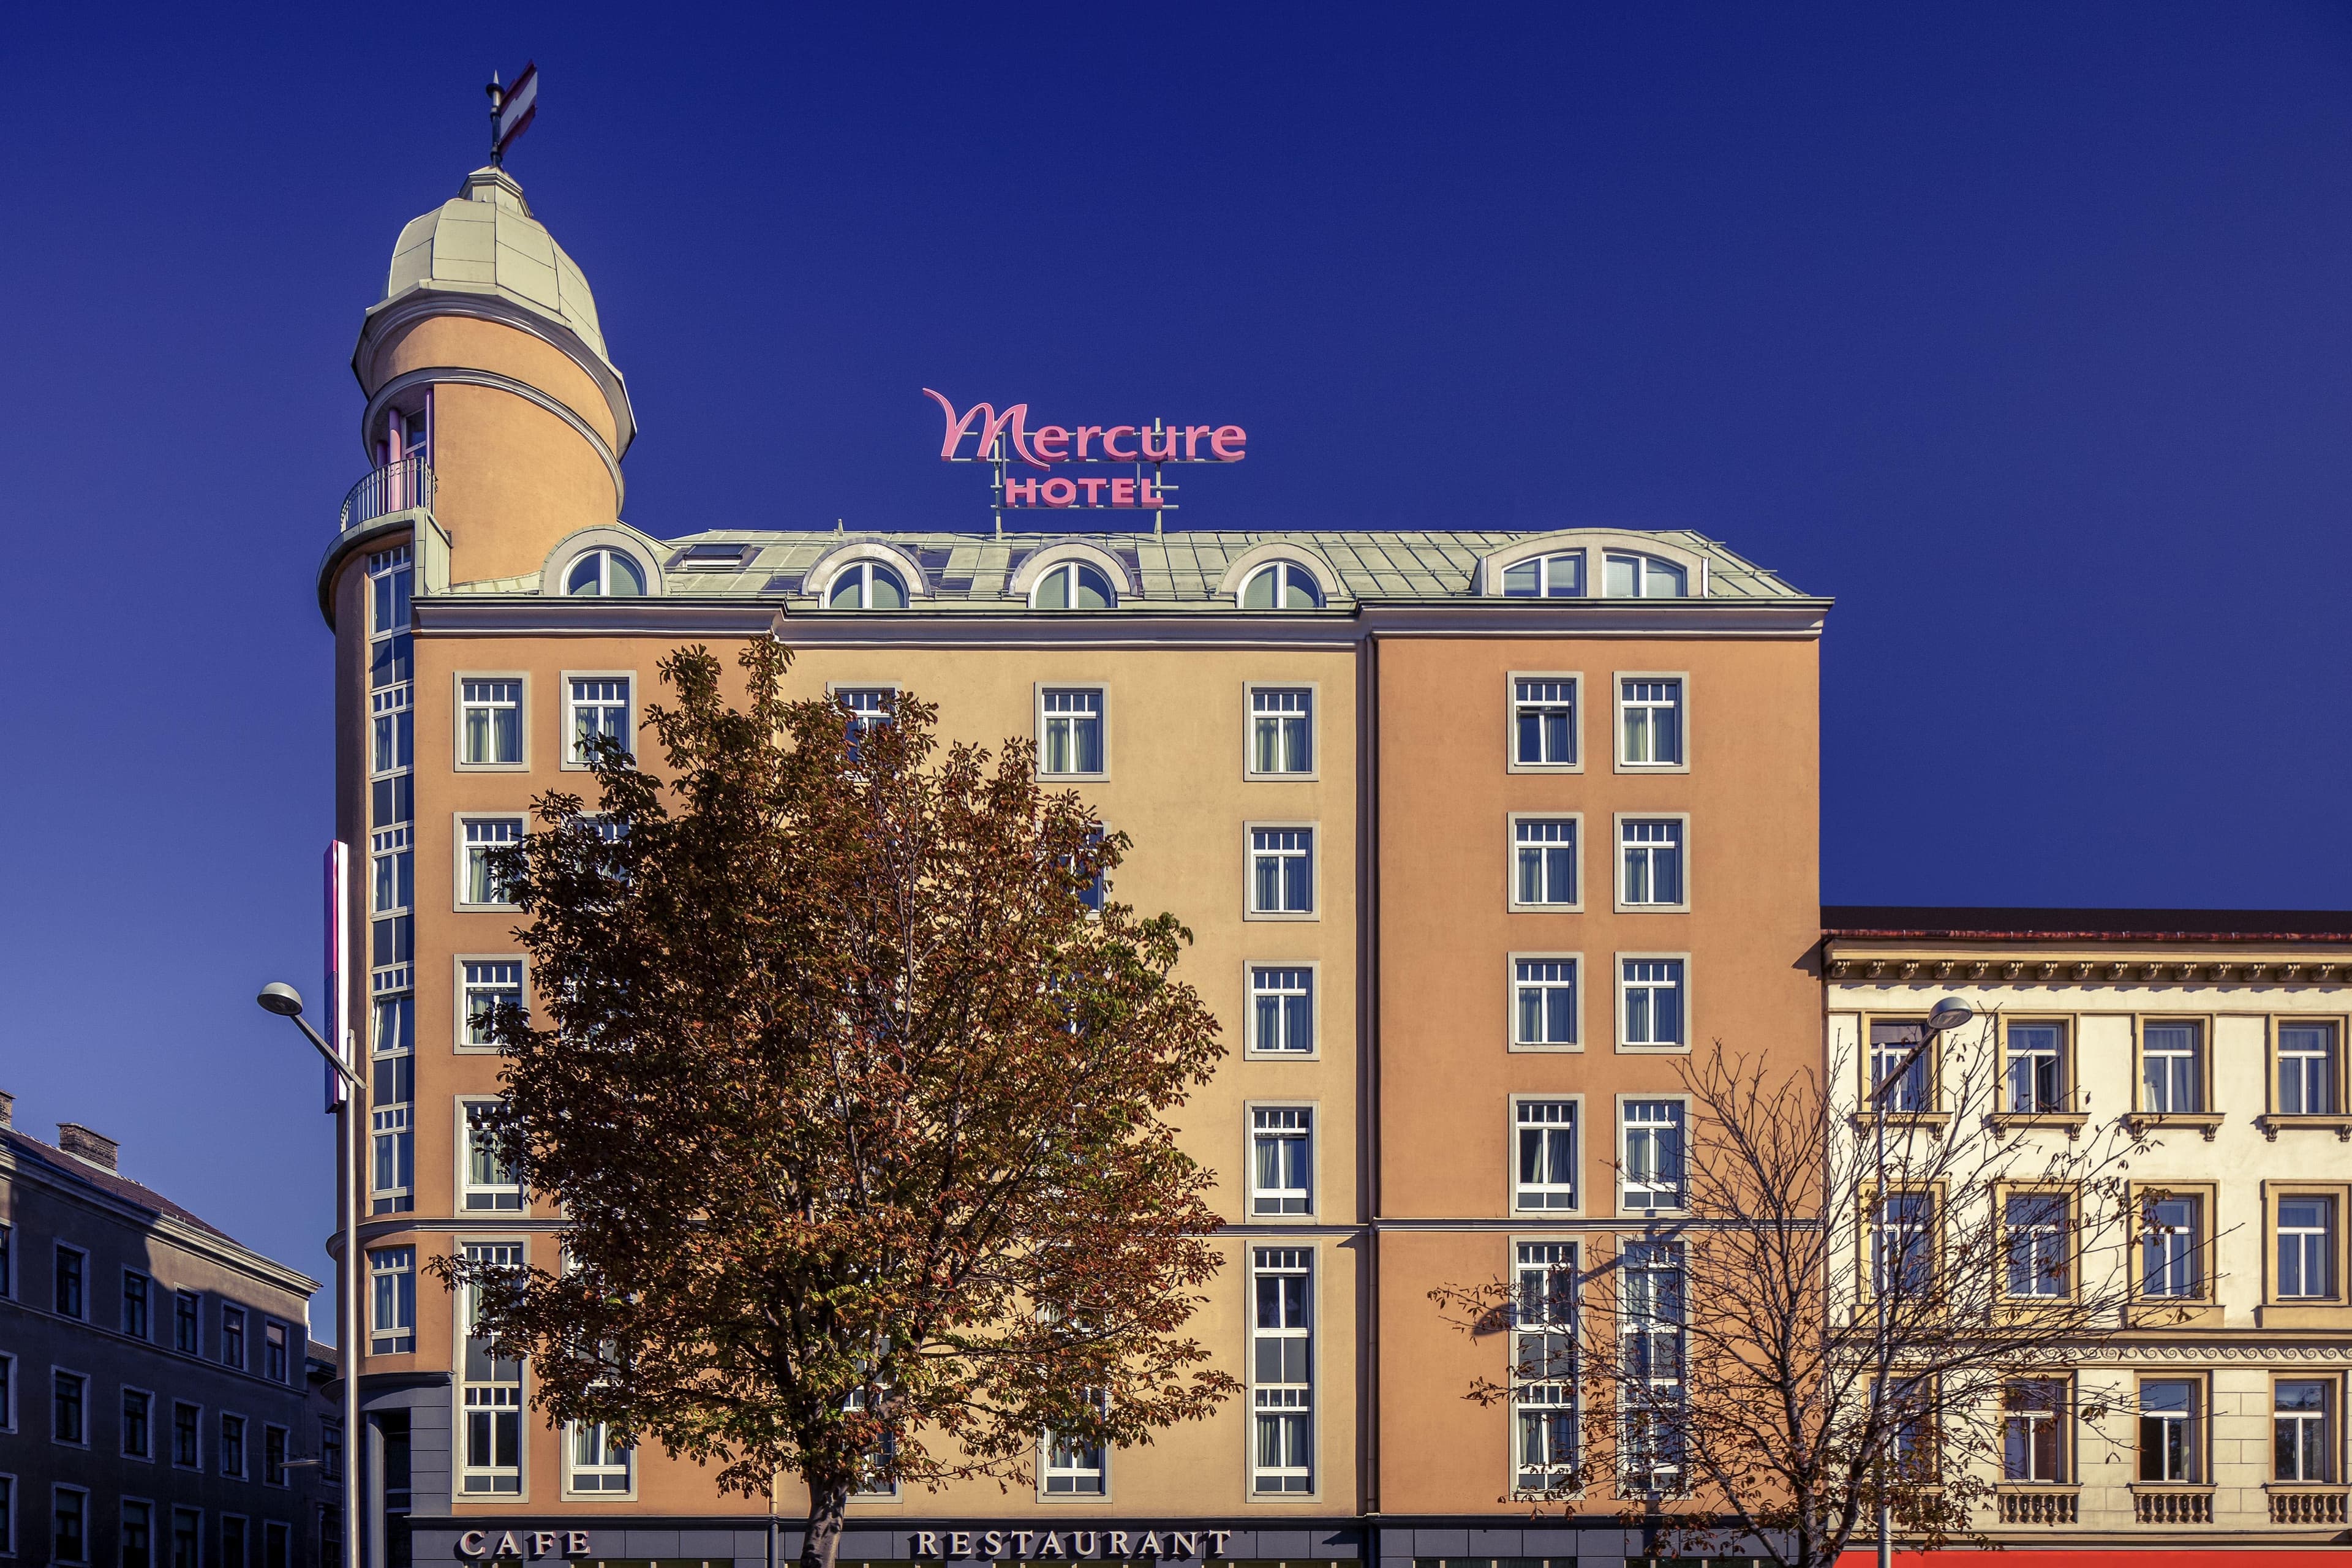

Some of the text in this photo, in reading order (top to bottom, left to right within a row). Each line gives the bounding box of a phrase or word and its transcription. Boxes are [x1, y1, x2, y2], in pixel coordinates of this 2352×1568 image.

[922, 387, 1246, 471] Mercure
[1005, 477, 1164, 508] HOTEL
[460, 1530, 591, 1556] CAFE
[916, 1529, 1231, 1556] RESTAURANT
